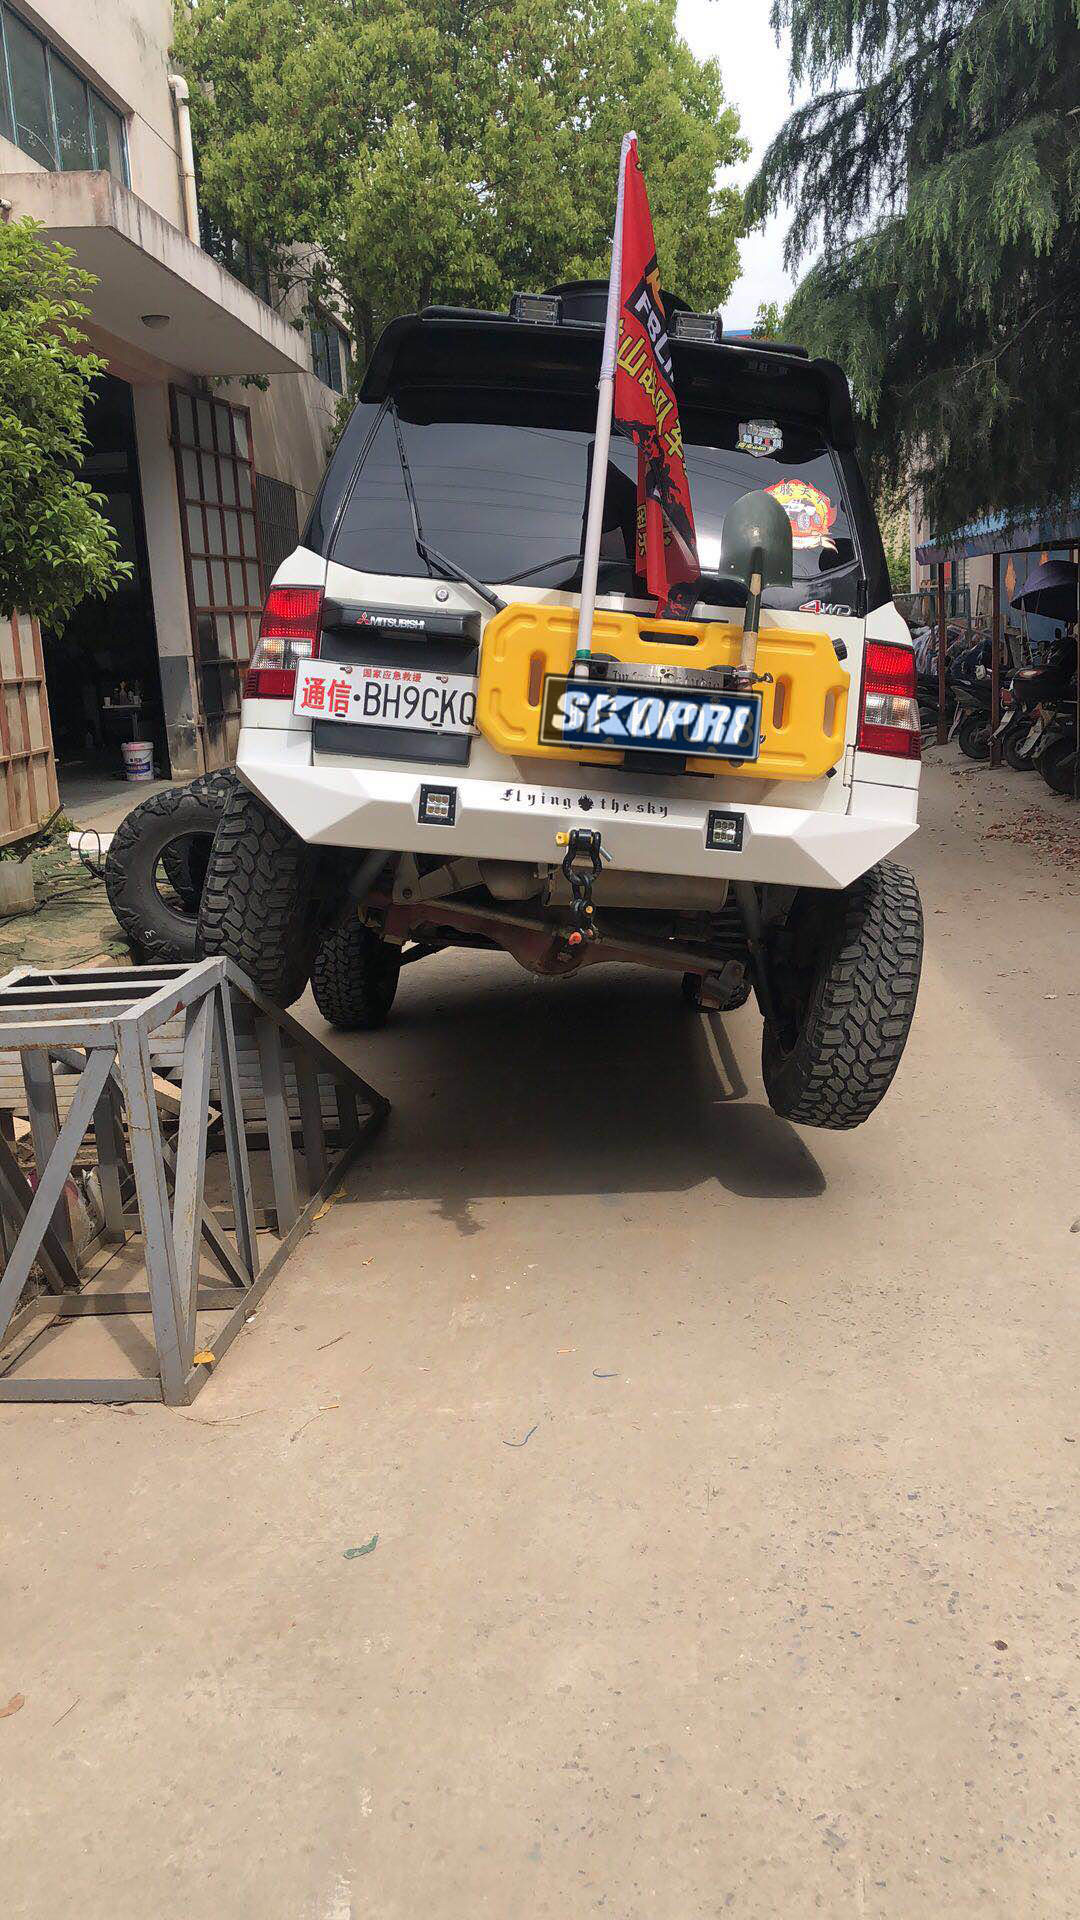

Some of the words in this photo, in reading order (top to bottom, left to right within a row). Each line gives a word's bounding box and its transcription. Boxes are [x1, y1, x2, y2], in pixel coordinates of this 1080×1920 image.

[799, 599, 852, 616] 4WD
[370, 615, 426, 630] MITSUBISHI
[362, 667, 422, 683] 国家应急救援
[499, 788, 572, 810] Flying
[600, 798, 630, 813] the
[635, 801, 669, 819] sky
